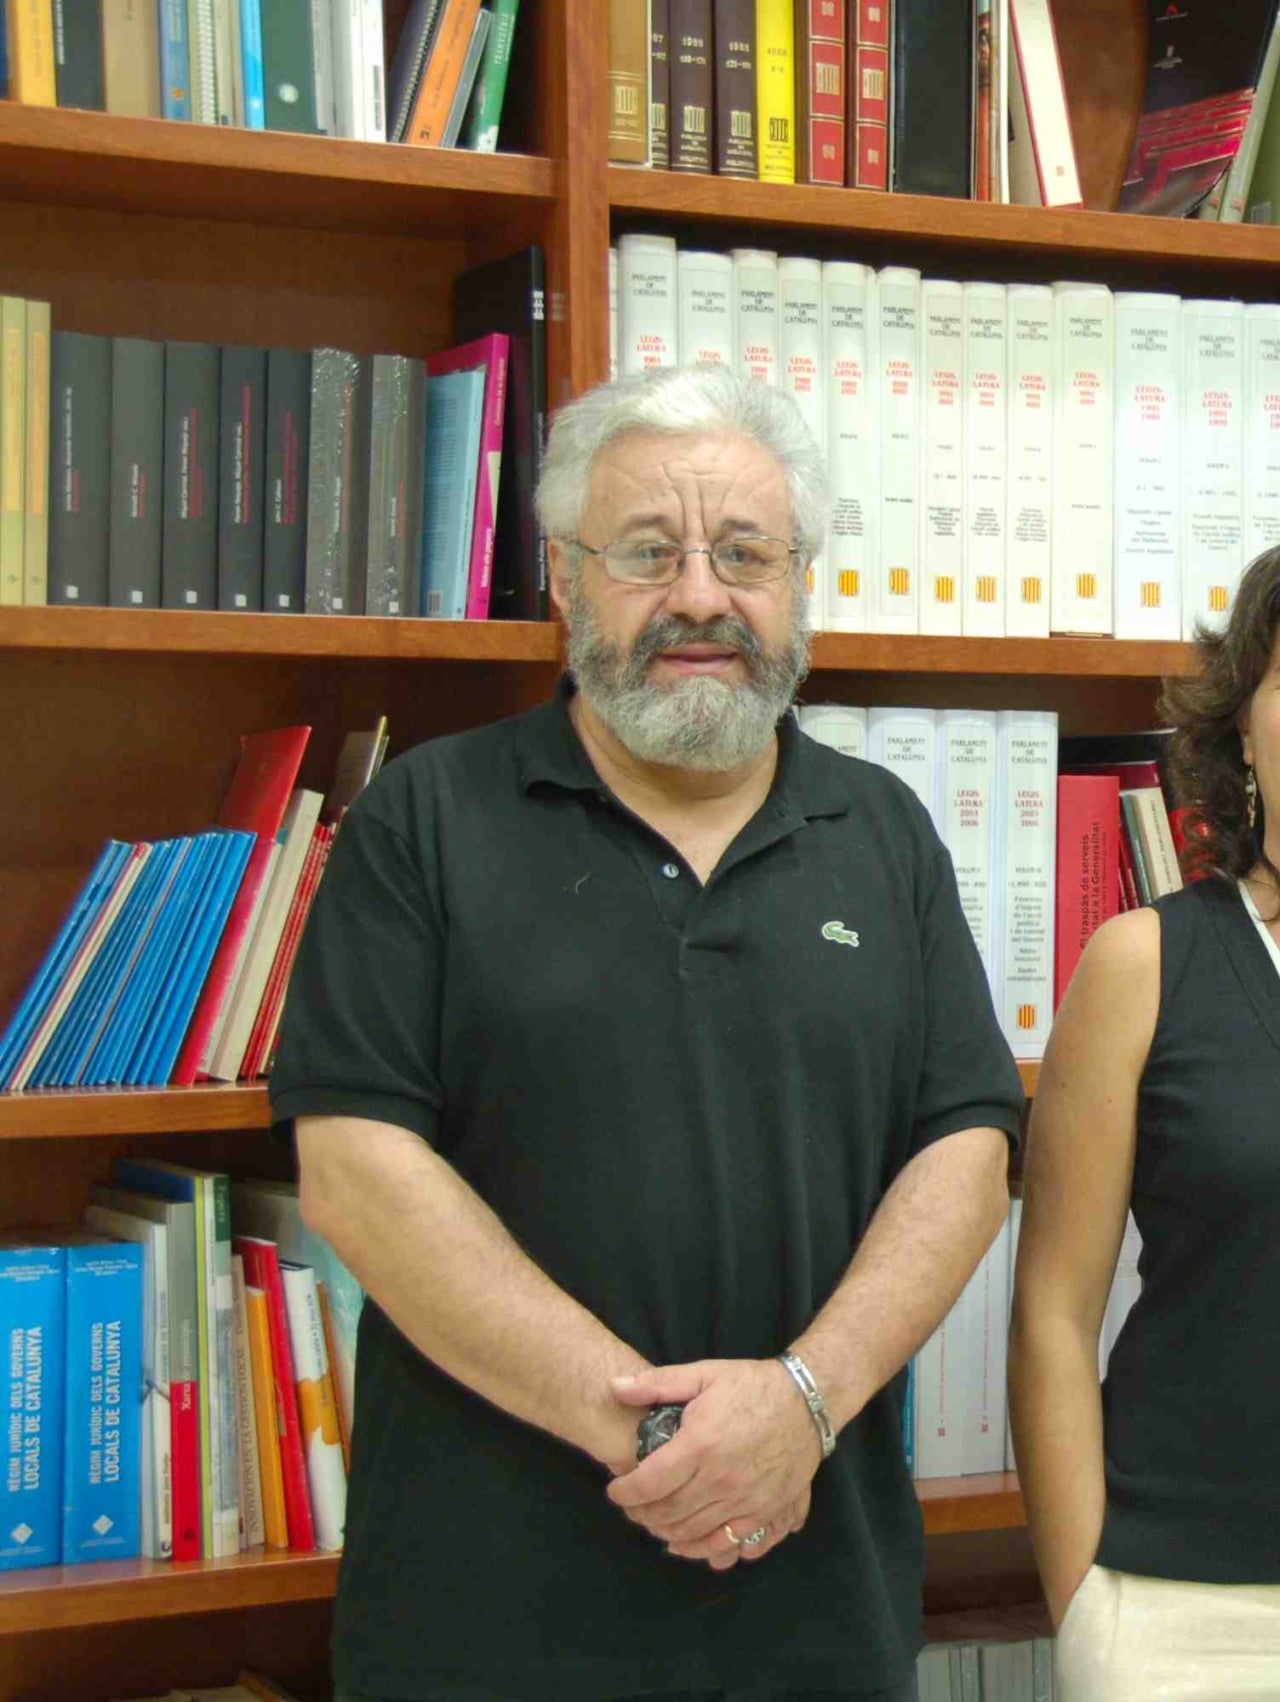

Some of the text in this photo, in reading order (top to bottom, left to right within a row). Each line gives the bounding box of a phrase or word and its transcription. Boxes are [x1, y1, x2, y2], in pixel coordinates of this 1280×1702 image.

[887, 737, 925, 745] PARLAMENT
[950, 739, 987, 748] PARLAMENT
[1011, 740, 1048, 749] PARLAMENT
[887, 753, 925, 762] CATALUNYA
[950, 756, 987, 764] CATALUNYA
[1012, 756, 1048, 765] CATALUNYA
[1080, 834, 1089, 874] serveis
[1090, 822, 1099, 885] Generalitat
[1080, 877, 1089, 891] de
[1091, 887, 1099, 896] la
[1080, 895, 1090, 936] traspàs
[88, 1323, 104, 1485] RÈGIM JURÍDIC DELS GOVERNS
[104, 1320, 121, 1482] LOCALS DE CATALUNYA
[181, 1383, 192, 1410] Xarxa
[7, 1328, 24, 1492] RÈGIM JURÍDIC DELS GOVERNS
[24, 1326, 42, 1490] LOCALS DE CATALUNYA
